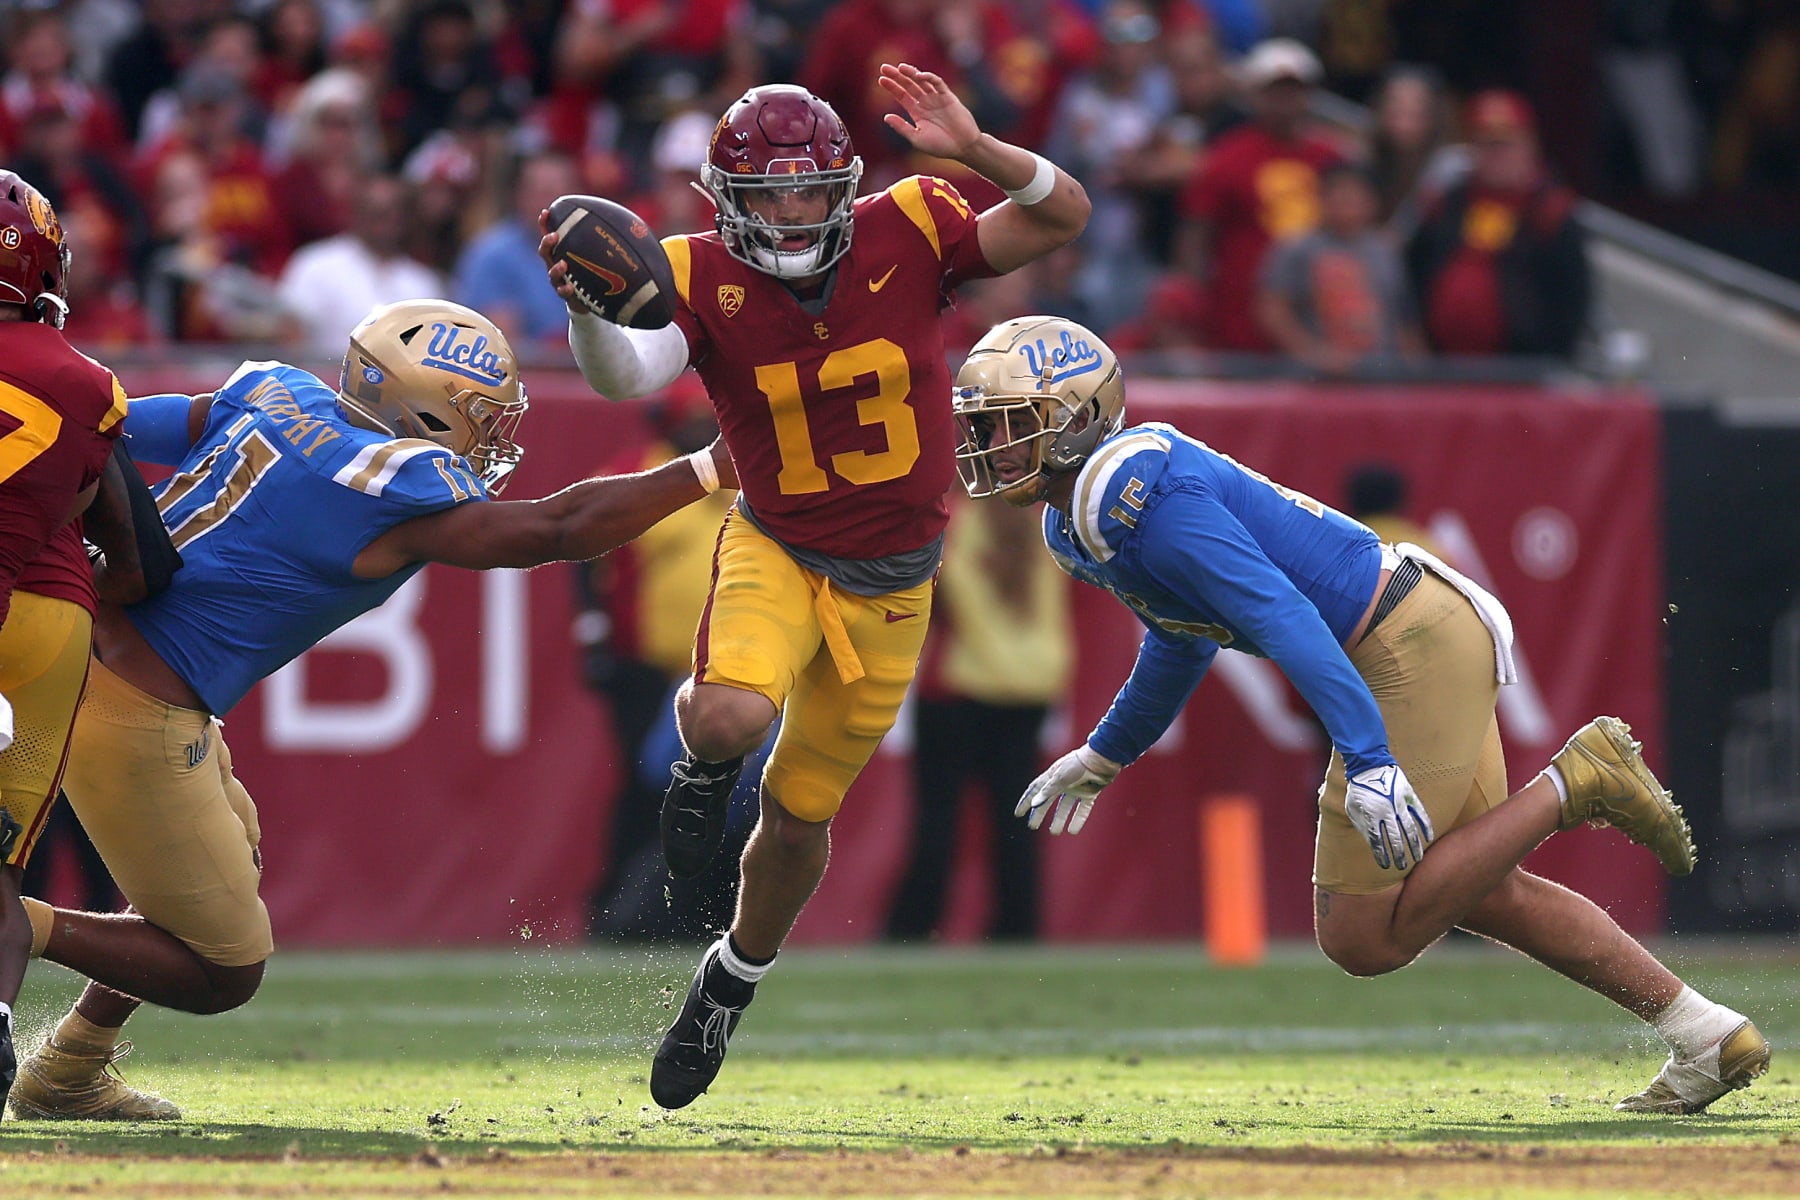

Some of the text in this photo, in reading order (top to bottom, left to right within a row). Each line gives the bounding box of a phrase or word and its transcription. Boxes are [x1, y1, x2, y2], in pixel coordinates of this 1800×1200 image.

[736, 162, 752, 173] USC
[831, 158, 844, 168] USC
[5, 231, 17, 245] 12
[718, 285, 745, 304] PAC
[723, 299, 737, 311] 12
[754, 337, 921, 495] 13
